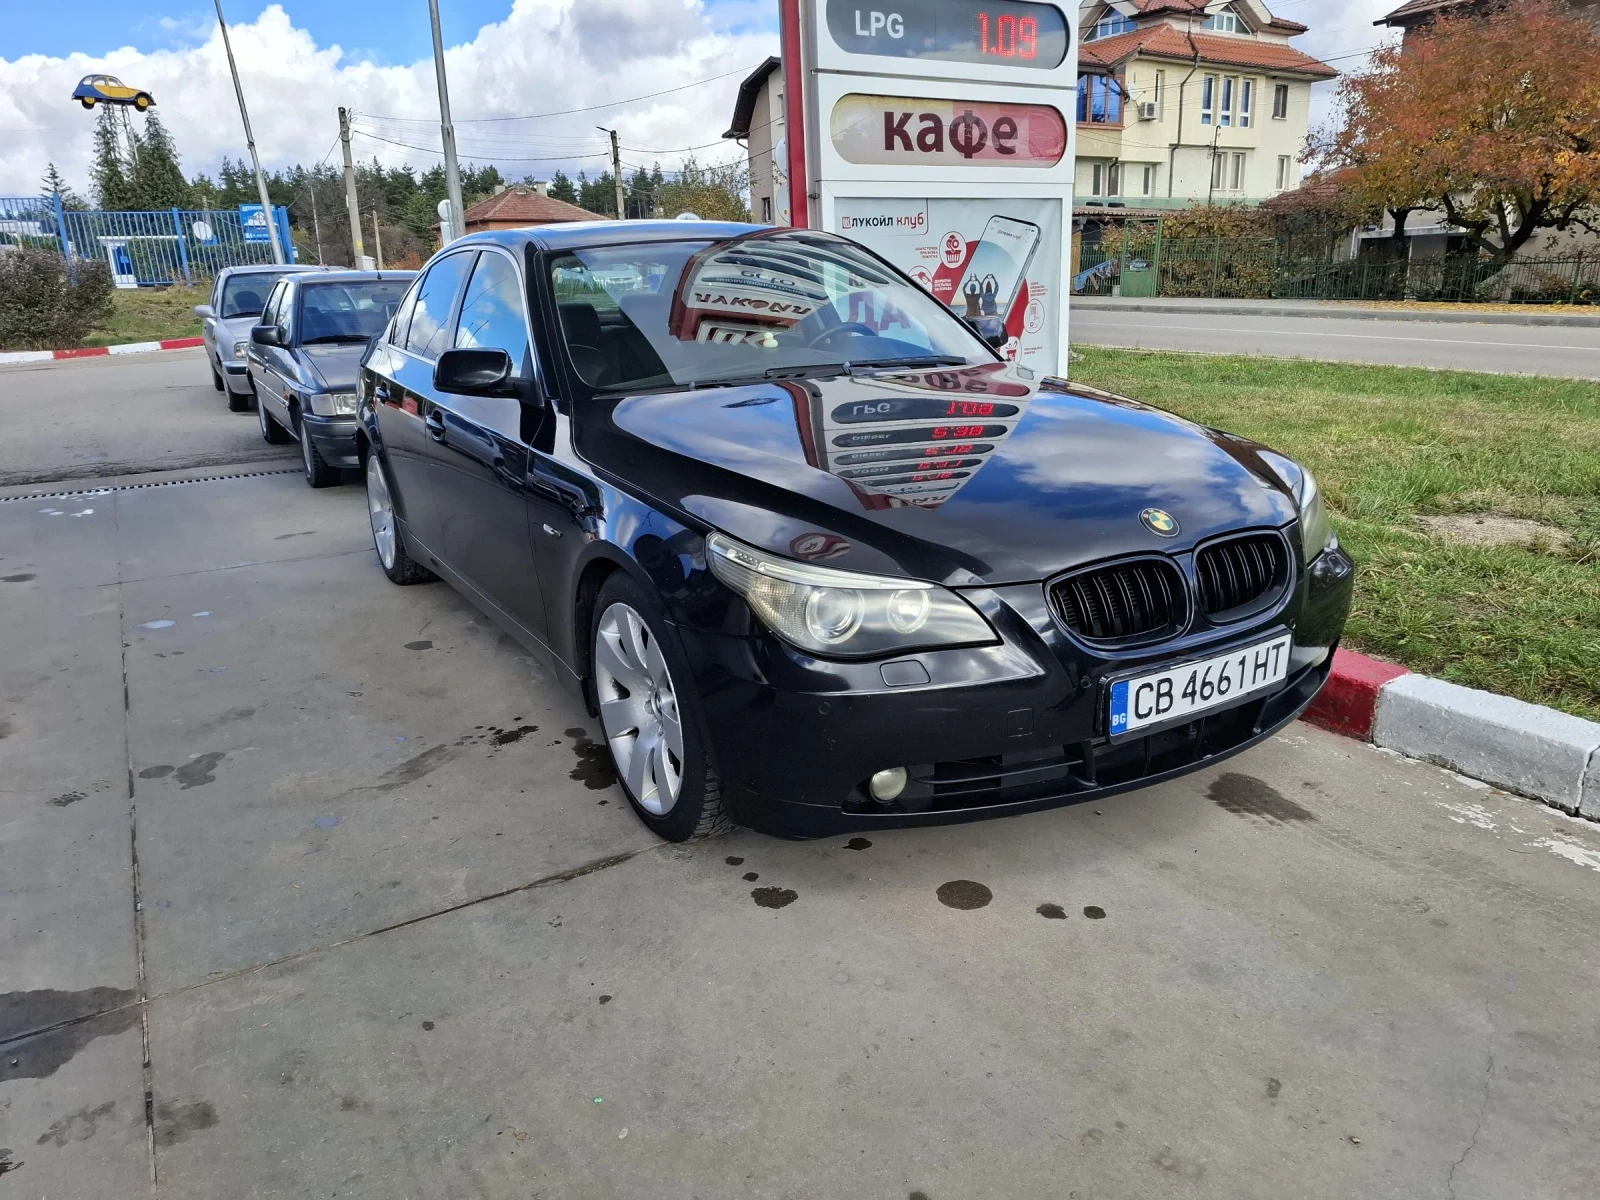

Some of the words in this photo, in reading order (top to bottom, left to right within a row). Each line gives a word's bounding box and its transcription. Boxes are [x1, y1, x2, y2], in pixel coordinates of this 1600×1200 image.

[855, 10, 904, 39] LPG
[978, 12, 1038, 60] 1.09
[883, 109, 1018, 159] кафе
[852, 214, 893, 227] ЛУКОЙЛ
[896, 212, 924, 229] клуб
[1134, 677, 1174, 720] CB
[1181, 655, 1247, 706] 4661
[1252, 641, 1286, 685] HT
[1112, 712, 1127, 727] BG
